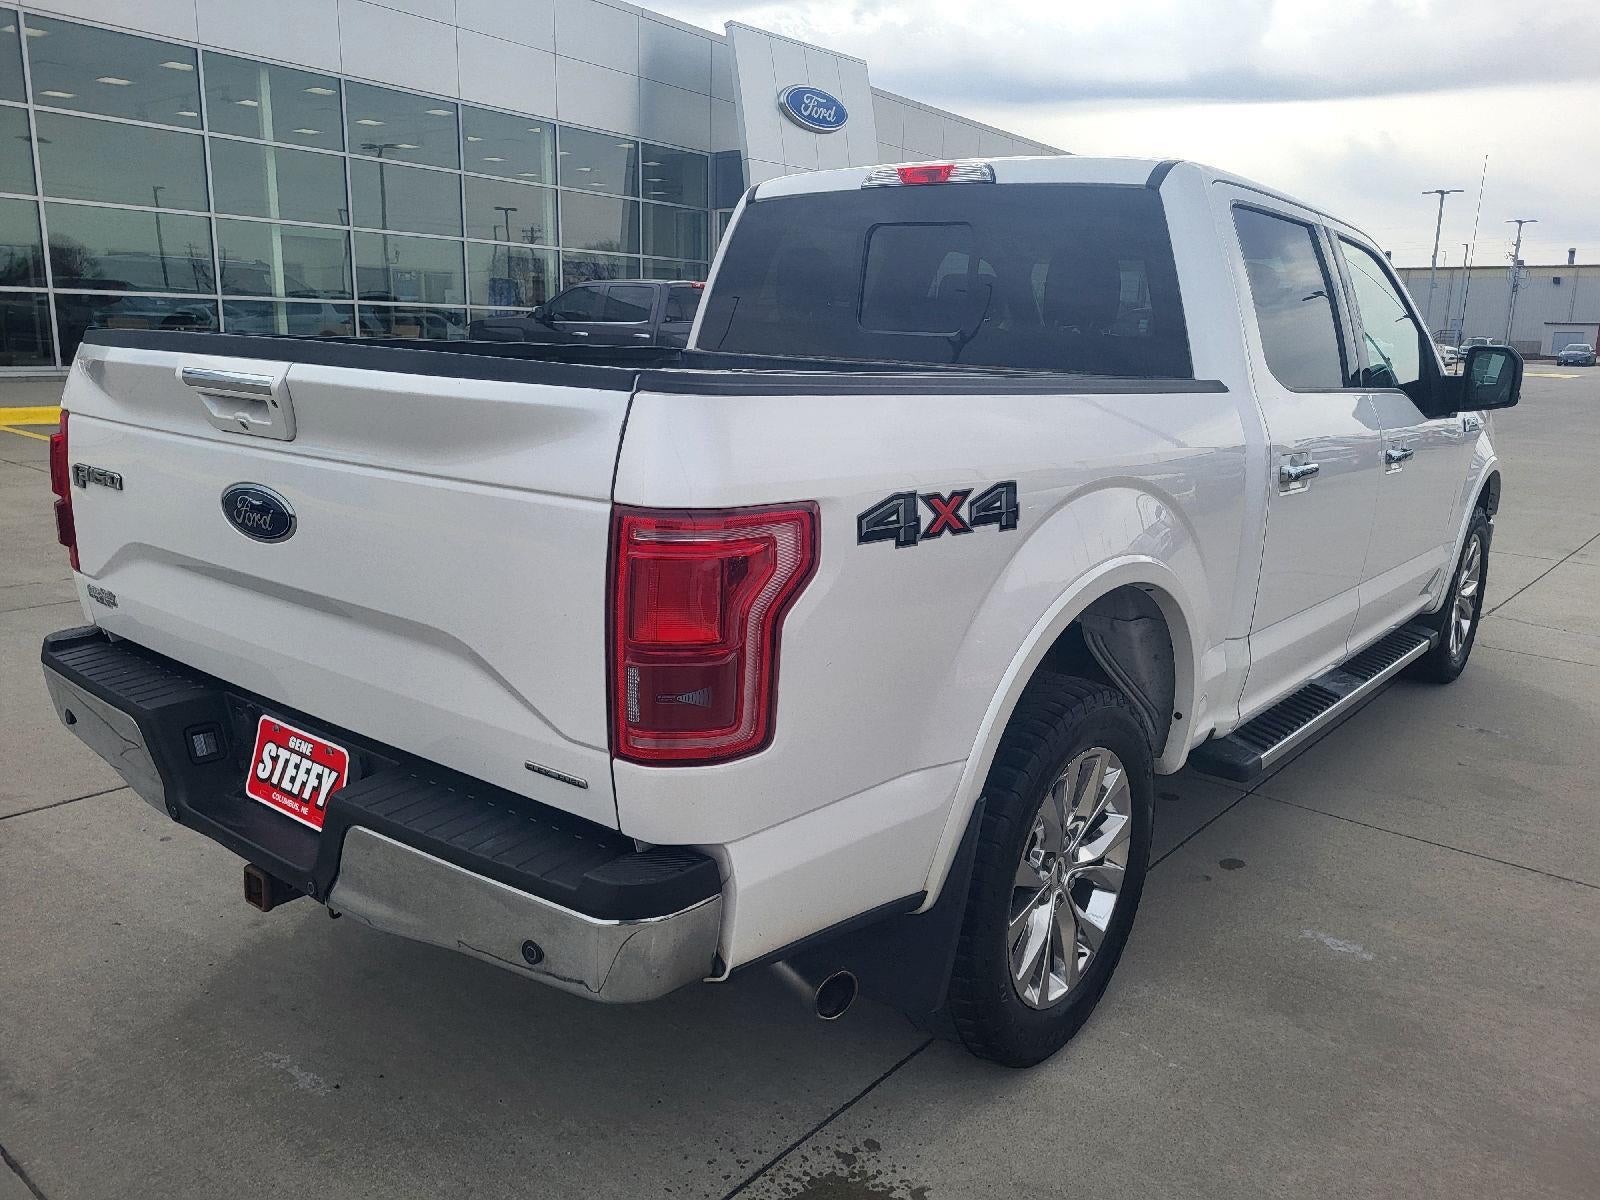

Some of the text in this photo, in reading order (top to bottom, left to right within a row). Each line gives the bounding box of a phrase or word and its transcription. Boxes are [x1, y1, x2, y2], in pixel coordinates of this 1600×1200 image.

[801, 93, 836, 122] Ford
[234, 495, 274, 531] Ford
[288, 735, 314, 756] GENE
[256, 741, 339, 808] STEFFY
[300, 806, 309, 815] NE
